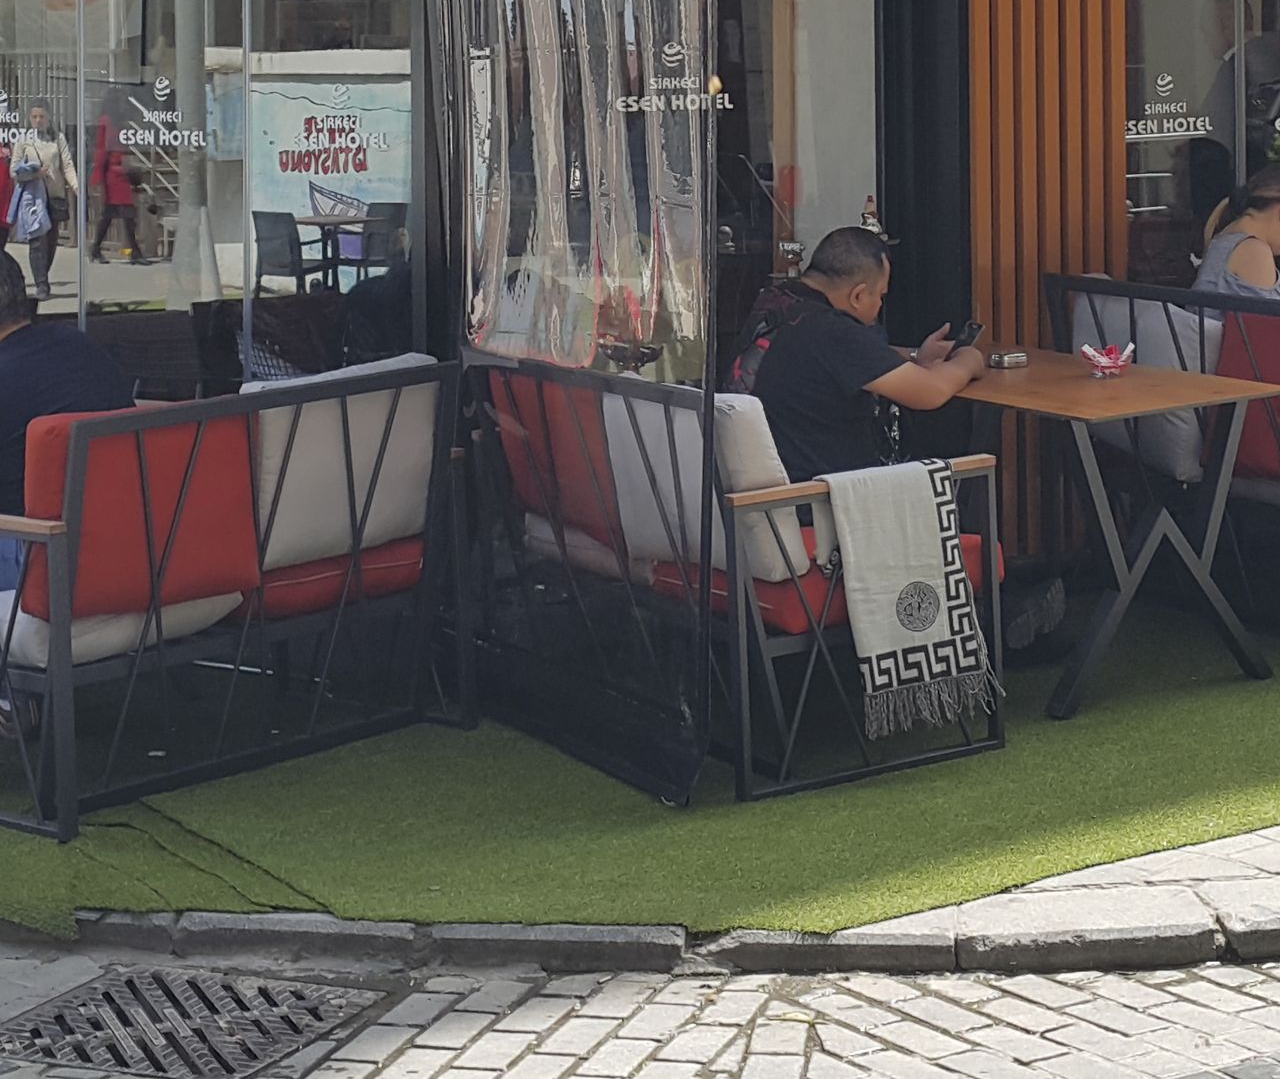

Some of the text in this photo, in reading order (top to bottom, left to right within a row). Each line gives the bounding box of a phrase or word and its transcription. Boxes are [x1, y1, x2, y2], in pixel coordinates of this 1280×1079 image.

[615, 94, 666, 112] ESEN
[1163, 116, 1213, 133] HOTEL
[0, 128, 39, 144] HOTEL
[119, 129, 207, 147] ESEN HOTEL
[336, 132, 389, 149] HOTEL
